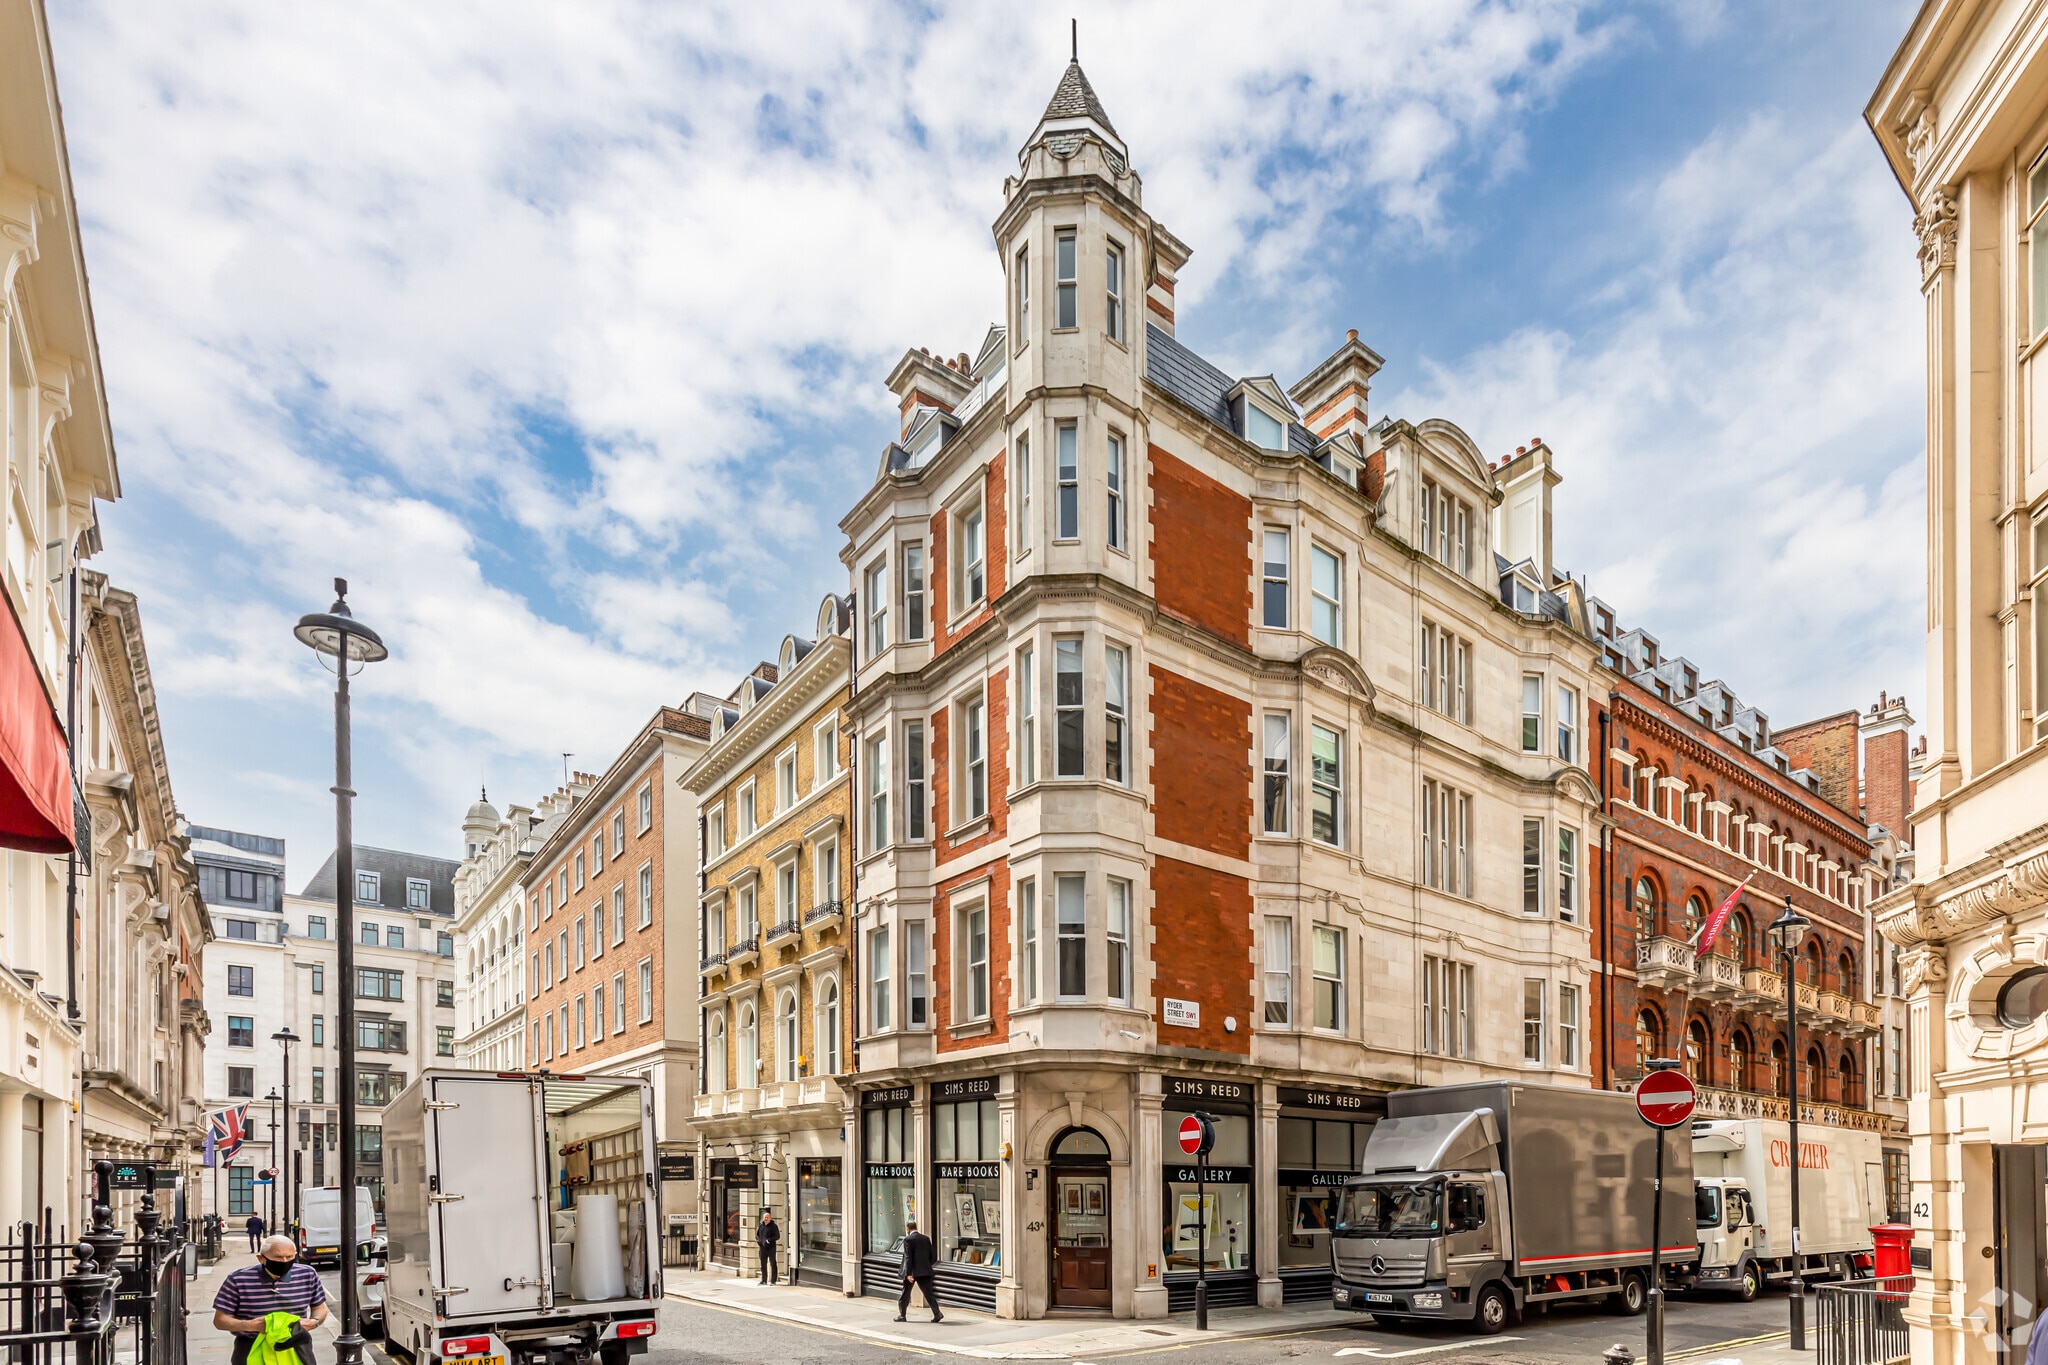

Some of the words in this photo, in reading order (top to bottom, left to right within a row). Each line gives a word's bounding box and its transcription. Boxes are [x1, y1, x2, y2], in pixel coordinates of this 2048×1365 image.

[1167, 1001, 1183, 1009] RYDER
[1167, 1009, 1184, 1018] STREET
[945, 1082, 963, 1095] SIMS
[969, 1080, 990, 1093] REED
[1175, 1082, 1203, 1095] SIMS
[1211, 1084, 1240, 1097] REED
[873, 1092, 888, 1102] SIMS
[892, 1089, 909, 1100] REED
[1307, 1093, 1331, 1105] SIMS
[1336, 1096, 1361, 1108] REED
[1770, 1139, 1829, 1169] CRZIER
[871, 1166, 888, 1176] RARE
[941, 1166, 963, 1177] RARE
[967, 1166, 999, 1177] BOOKS
[1178, 1169, 1232, 1181] GALERY
[1913, 1203, 1929, 1218] 42
[1026, 1221, 1045, 1232] 43A
